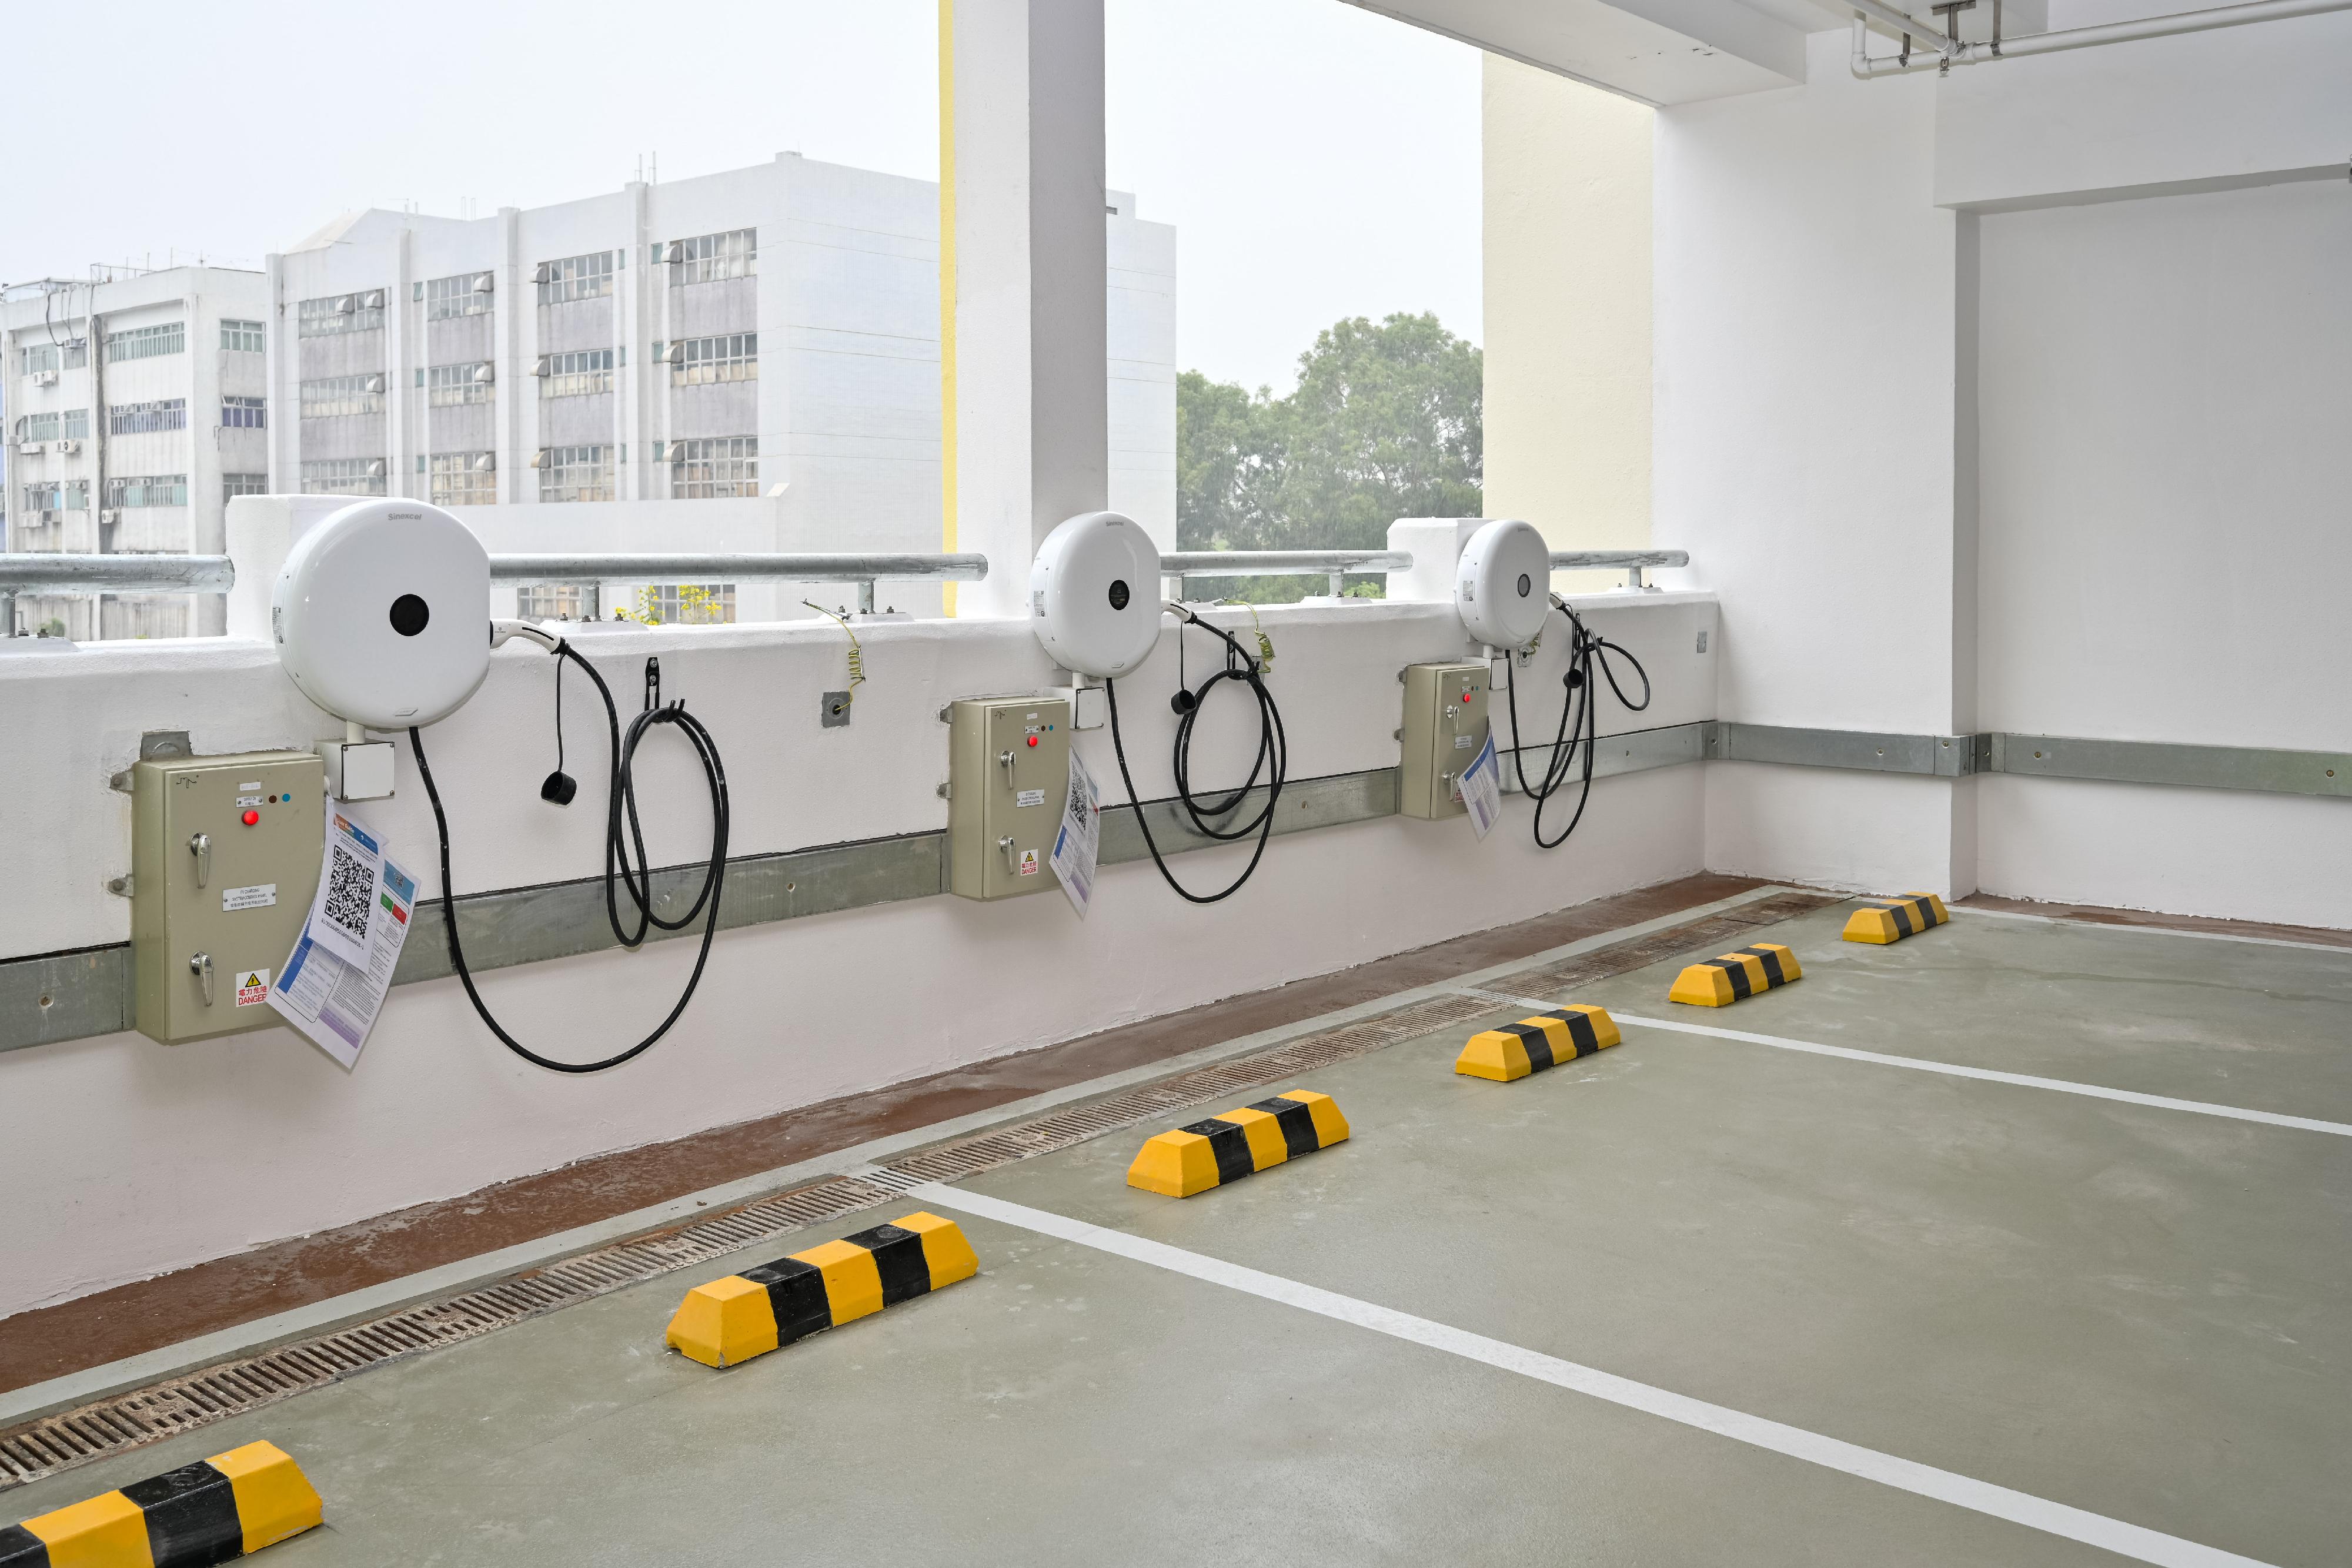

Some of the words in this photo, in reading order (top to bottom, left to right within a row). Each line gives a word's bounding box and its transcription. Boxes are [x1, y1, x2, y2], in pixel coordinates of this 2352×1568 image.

[239, 986, 267, 996] 電力危險
[239, 994, 267, 1005] DANGER
